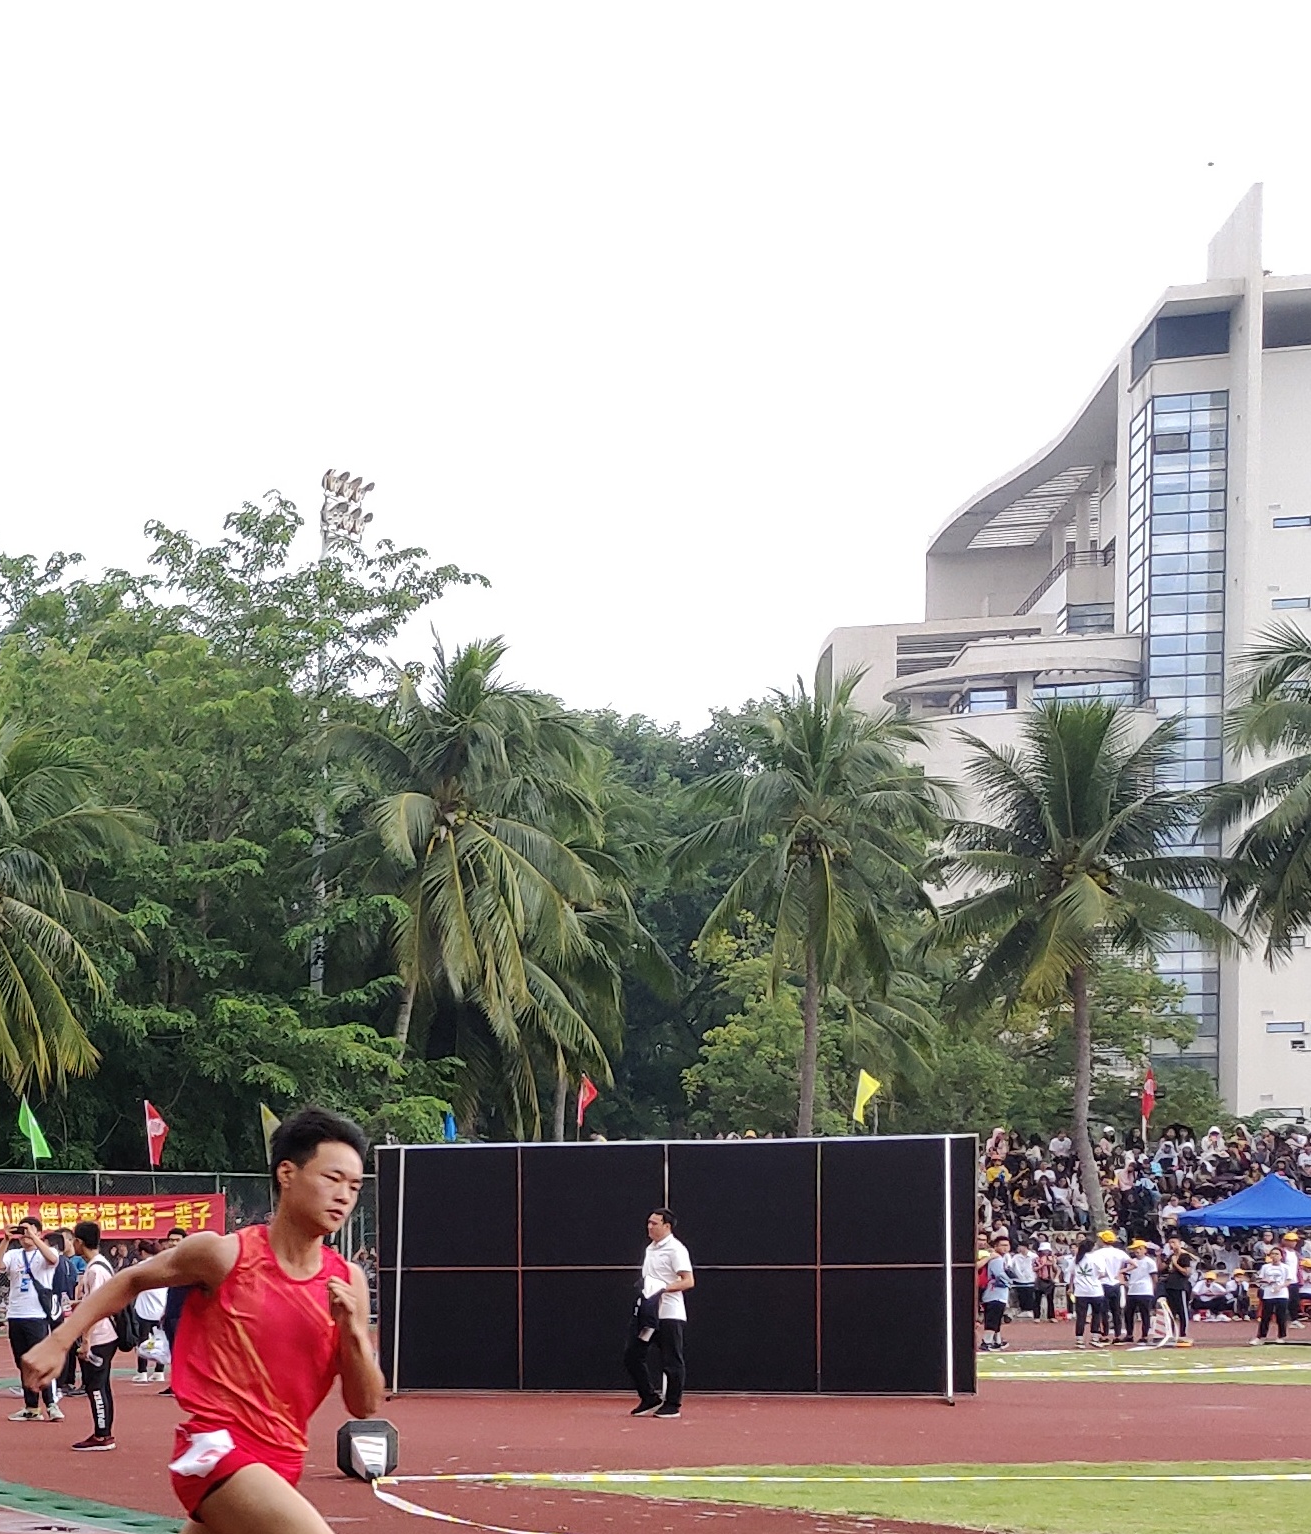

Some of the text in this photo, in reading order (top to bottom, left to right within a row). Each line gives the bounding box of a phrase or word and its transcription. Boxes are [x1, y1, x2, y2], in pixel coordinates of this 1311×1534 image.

[39, 1201, 212, 1231] 健康幸福生活一辈子
